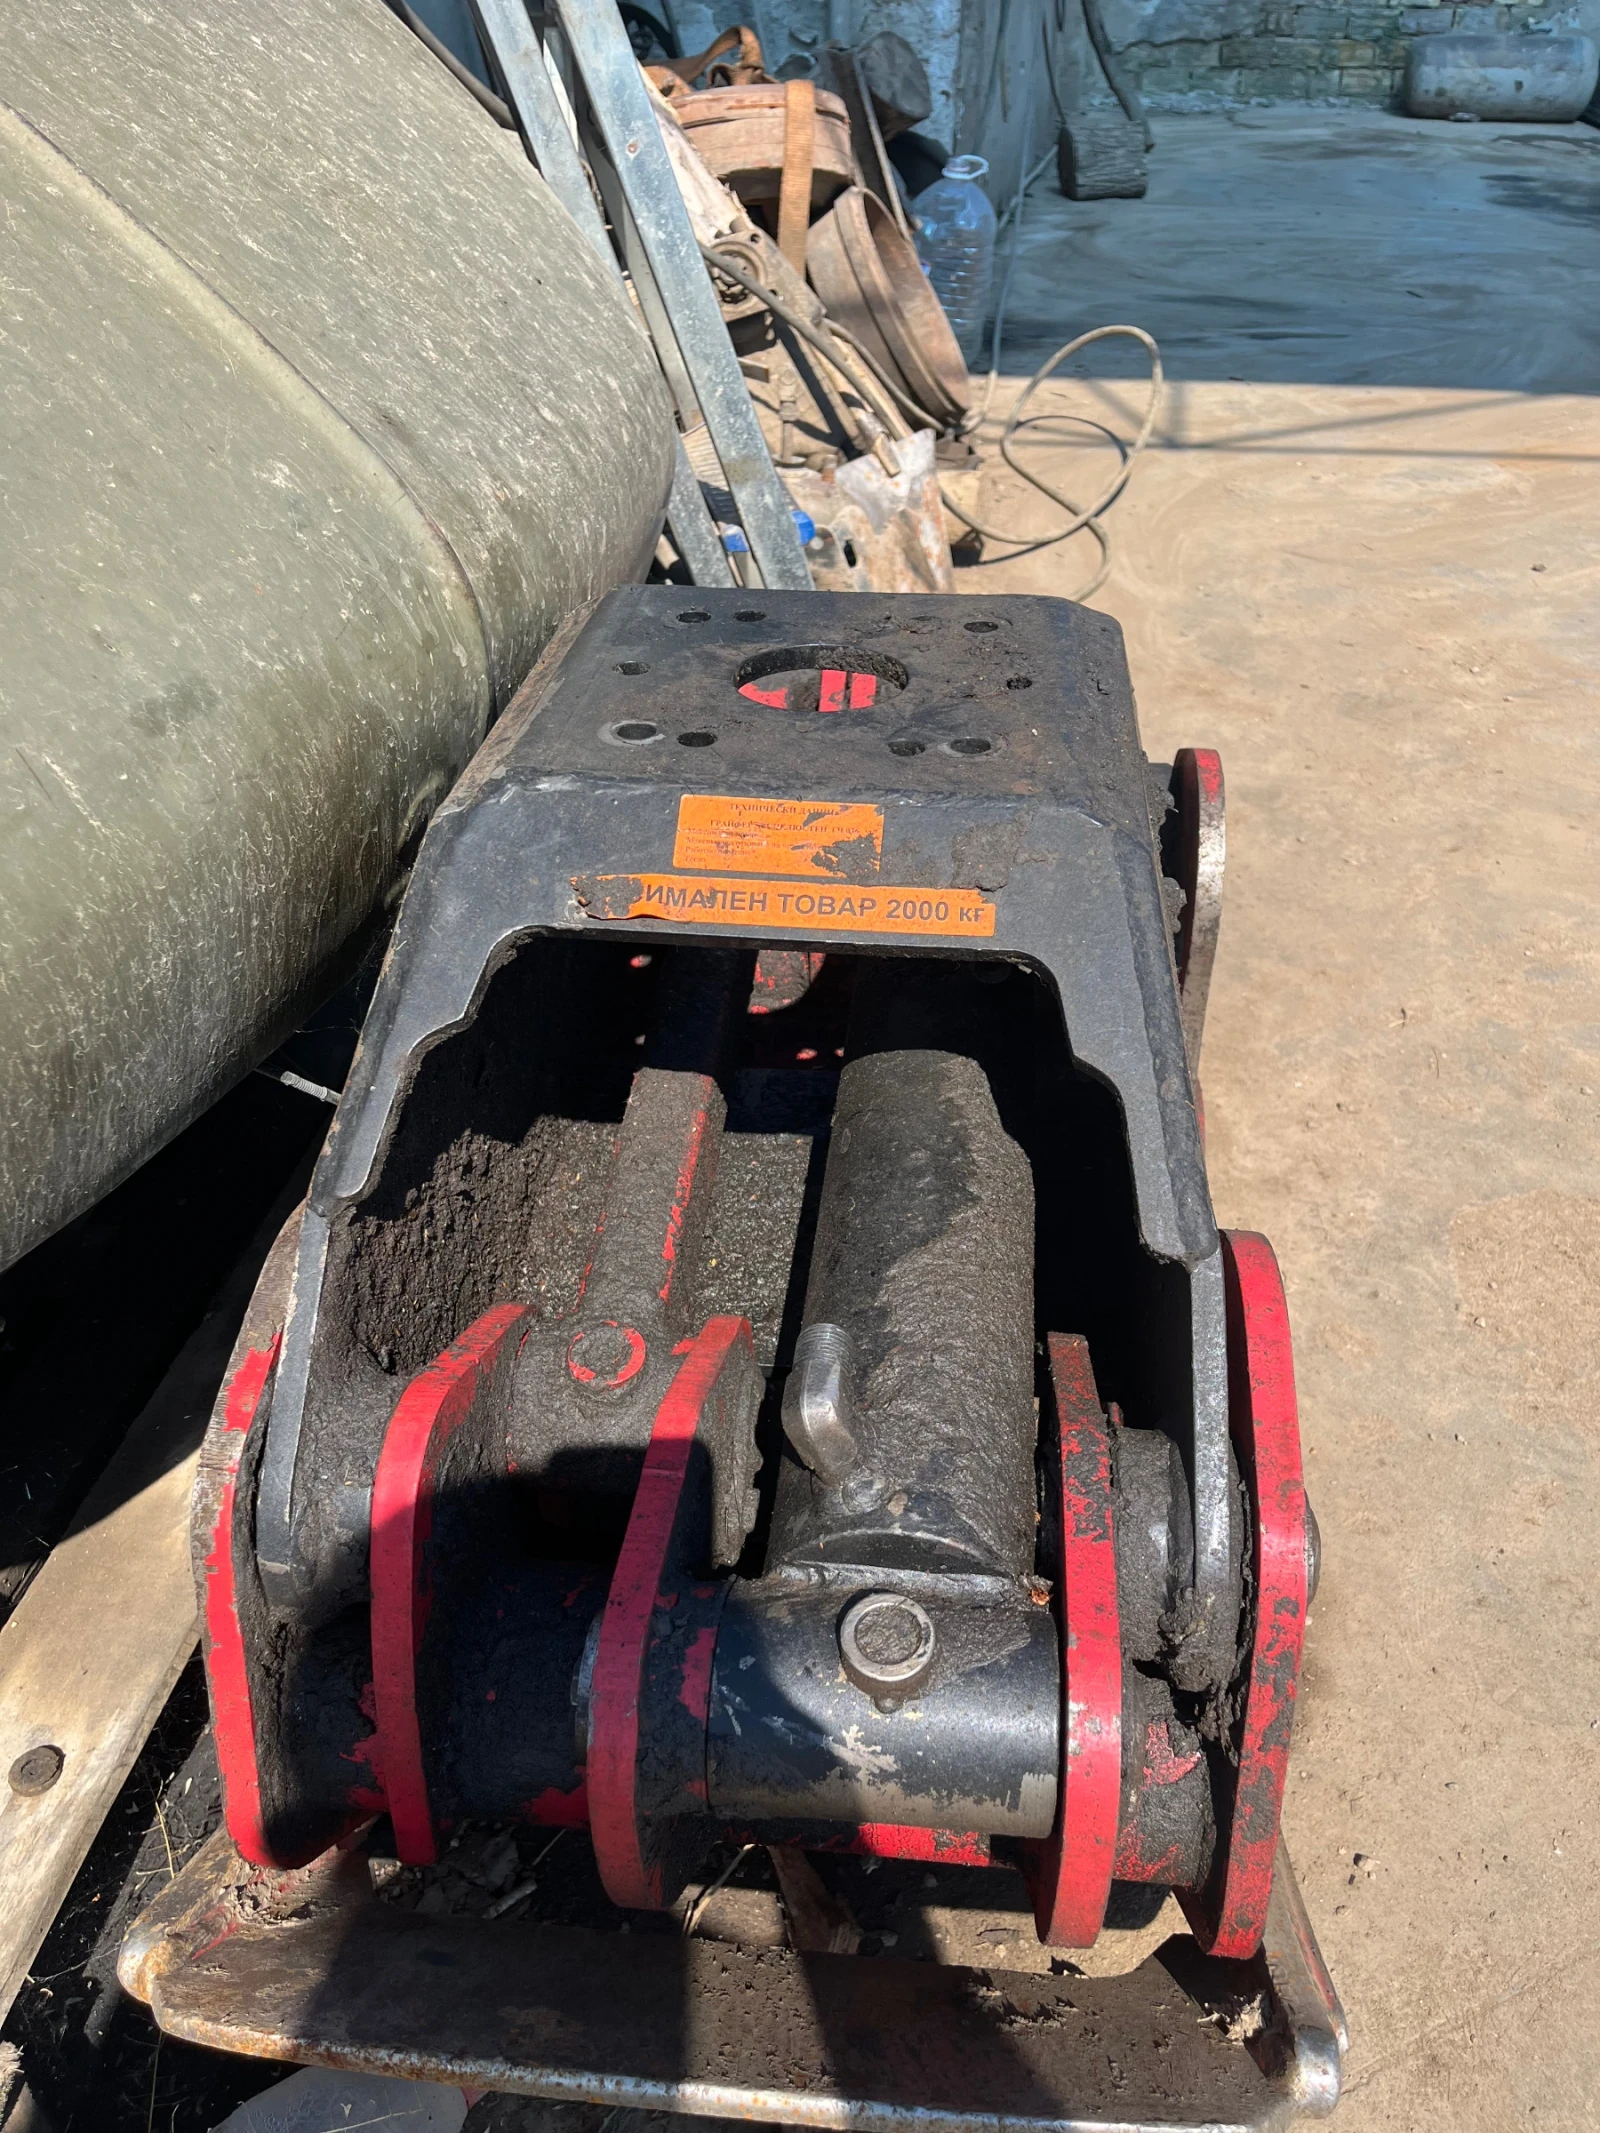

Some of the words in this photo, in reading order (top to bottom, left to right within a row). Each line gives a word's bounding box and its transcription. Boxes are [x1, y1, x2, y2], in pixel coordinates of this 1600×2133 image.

[636, 884, 767, 912] ИМАЛЕН
[777, 893, 877, 917] ТОВАР
[885, 899, 950, 922] 2000
